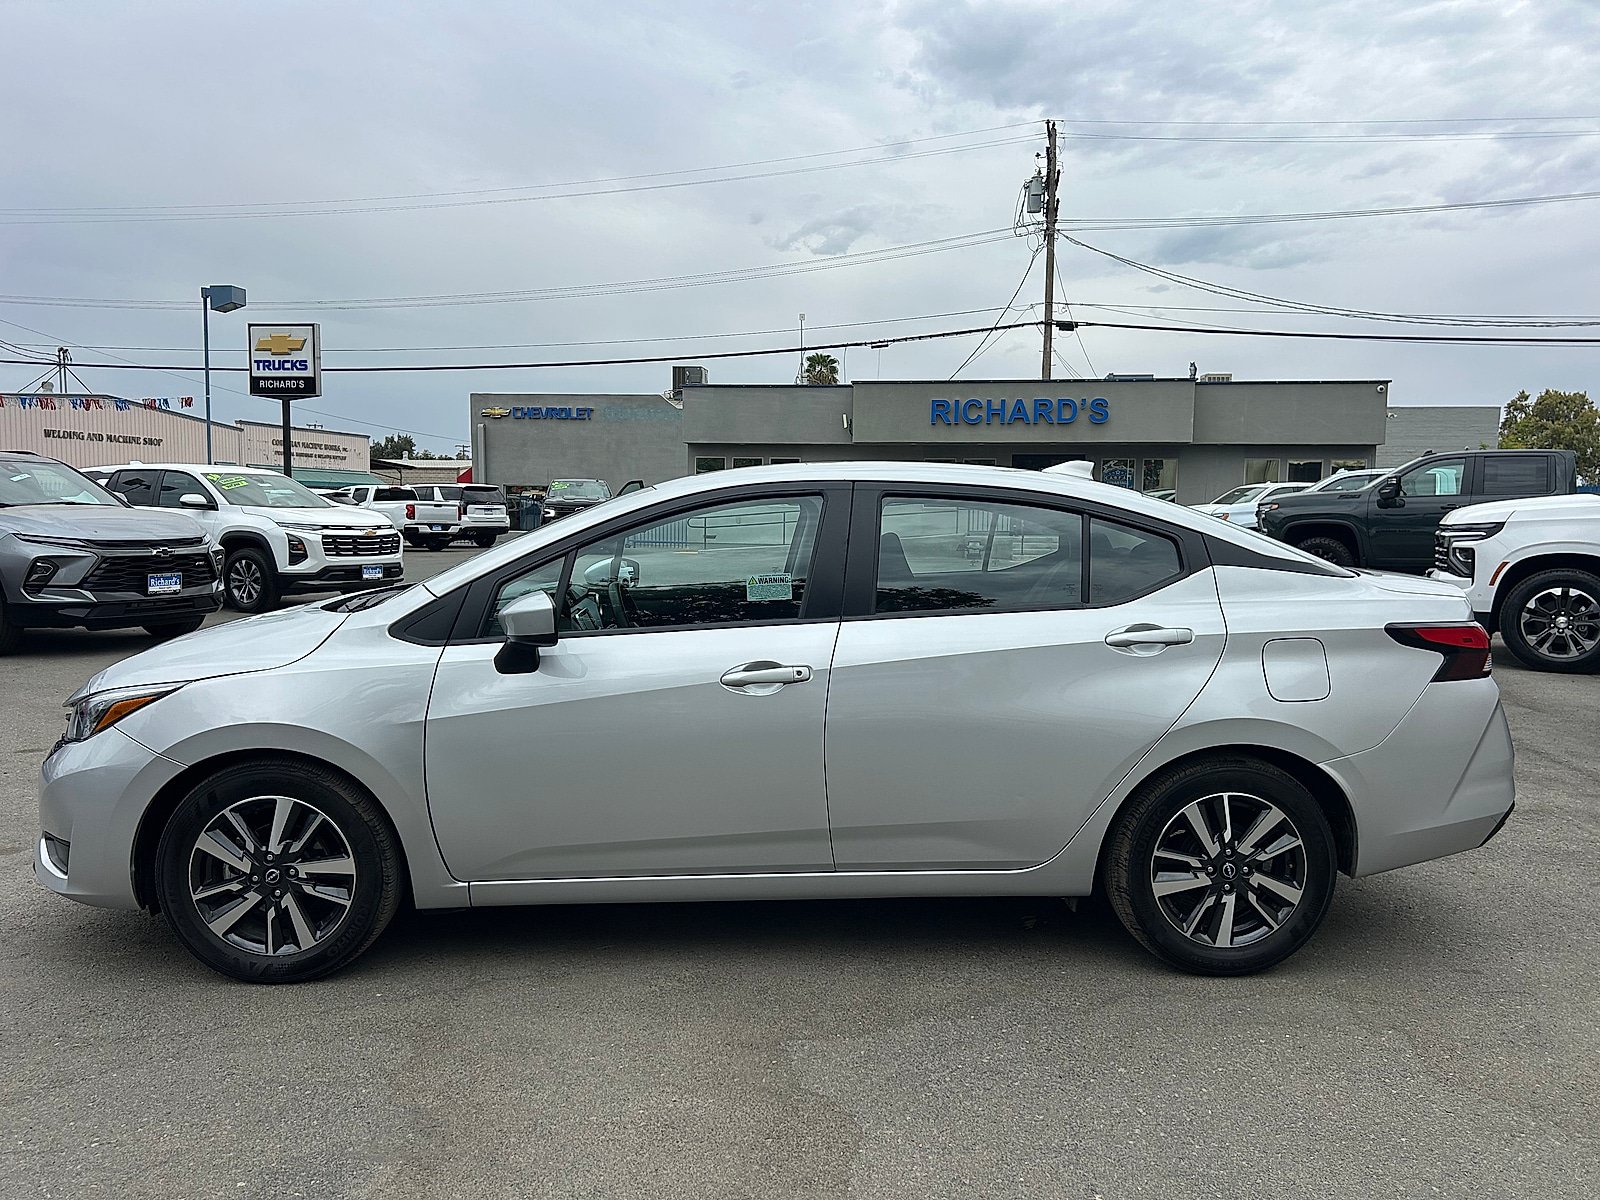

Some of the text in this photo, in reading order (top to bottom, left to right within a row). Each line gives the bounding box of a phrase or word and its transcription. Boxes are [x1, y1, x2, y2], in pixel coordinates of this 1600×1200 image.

[254, 359, 308, 371] TRUCKS
[259, 380, 305, 388] RICHARD'S
[512, 406, 595, 420] CHEVROLET
[43, 428, 163, 447] WELDING AND MACHINE SHOP
[150, 576, 180, 587] Richard's
